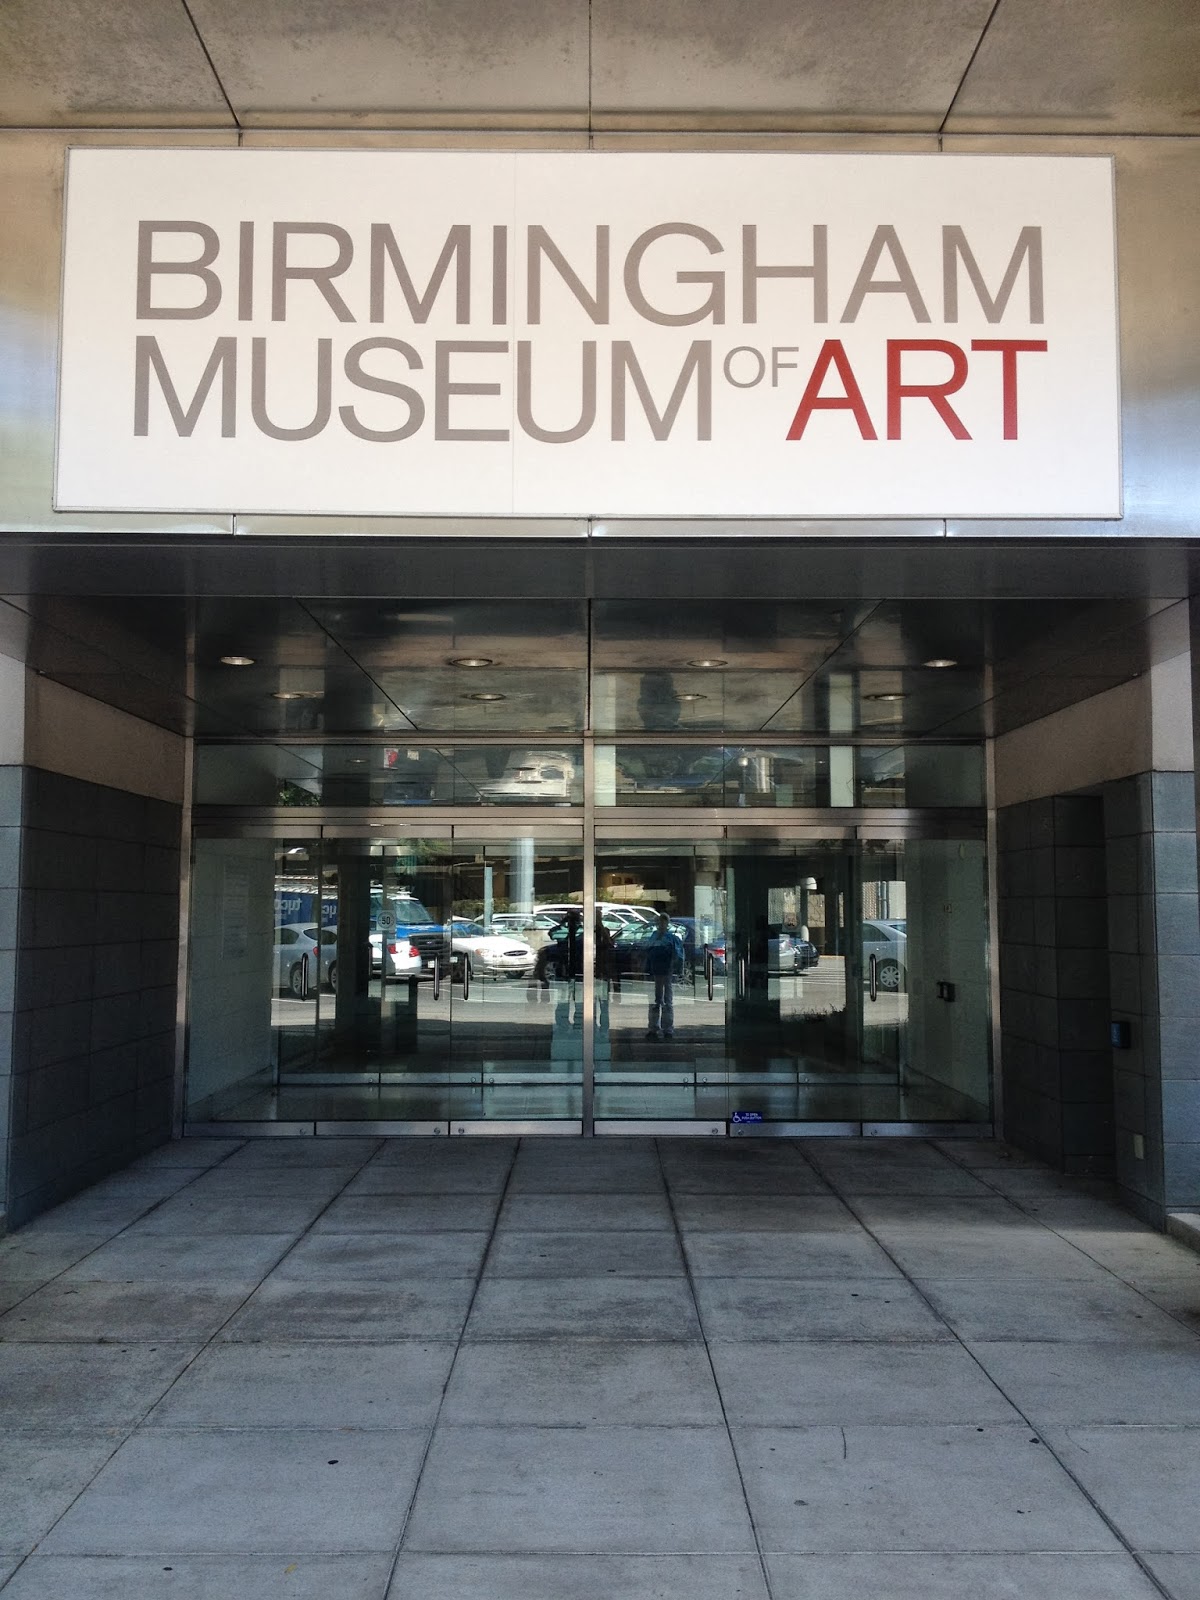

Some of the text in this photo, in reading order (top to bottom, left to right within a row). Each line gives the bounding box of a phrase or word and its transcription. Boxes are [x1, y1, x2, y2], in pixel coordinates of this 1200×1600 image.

[137, 220, 1043, 327] BIRMINGHAM
[134, 336, 1048, 443] MUSEUM OF ART
[381, 916, 391, 925] 50
